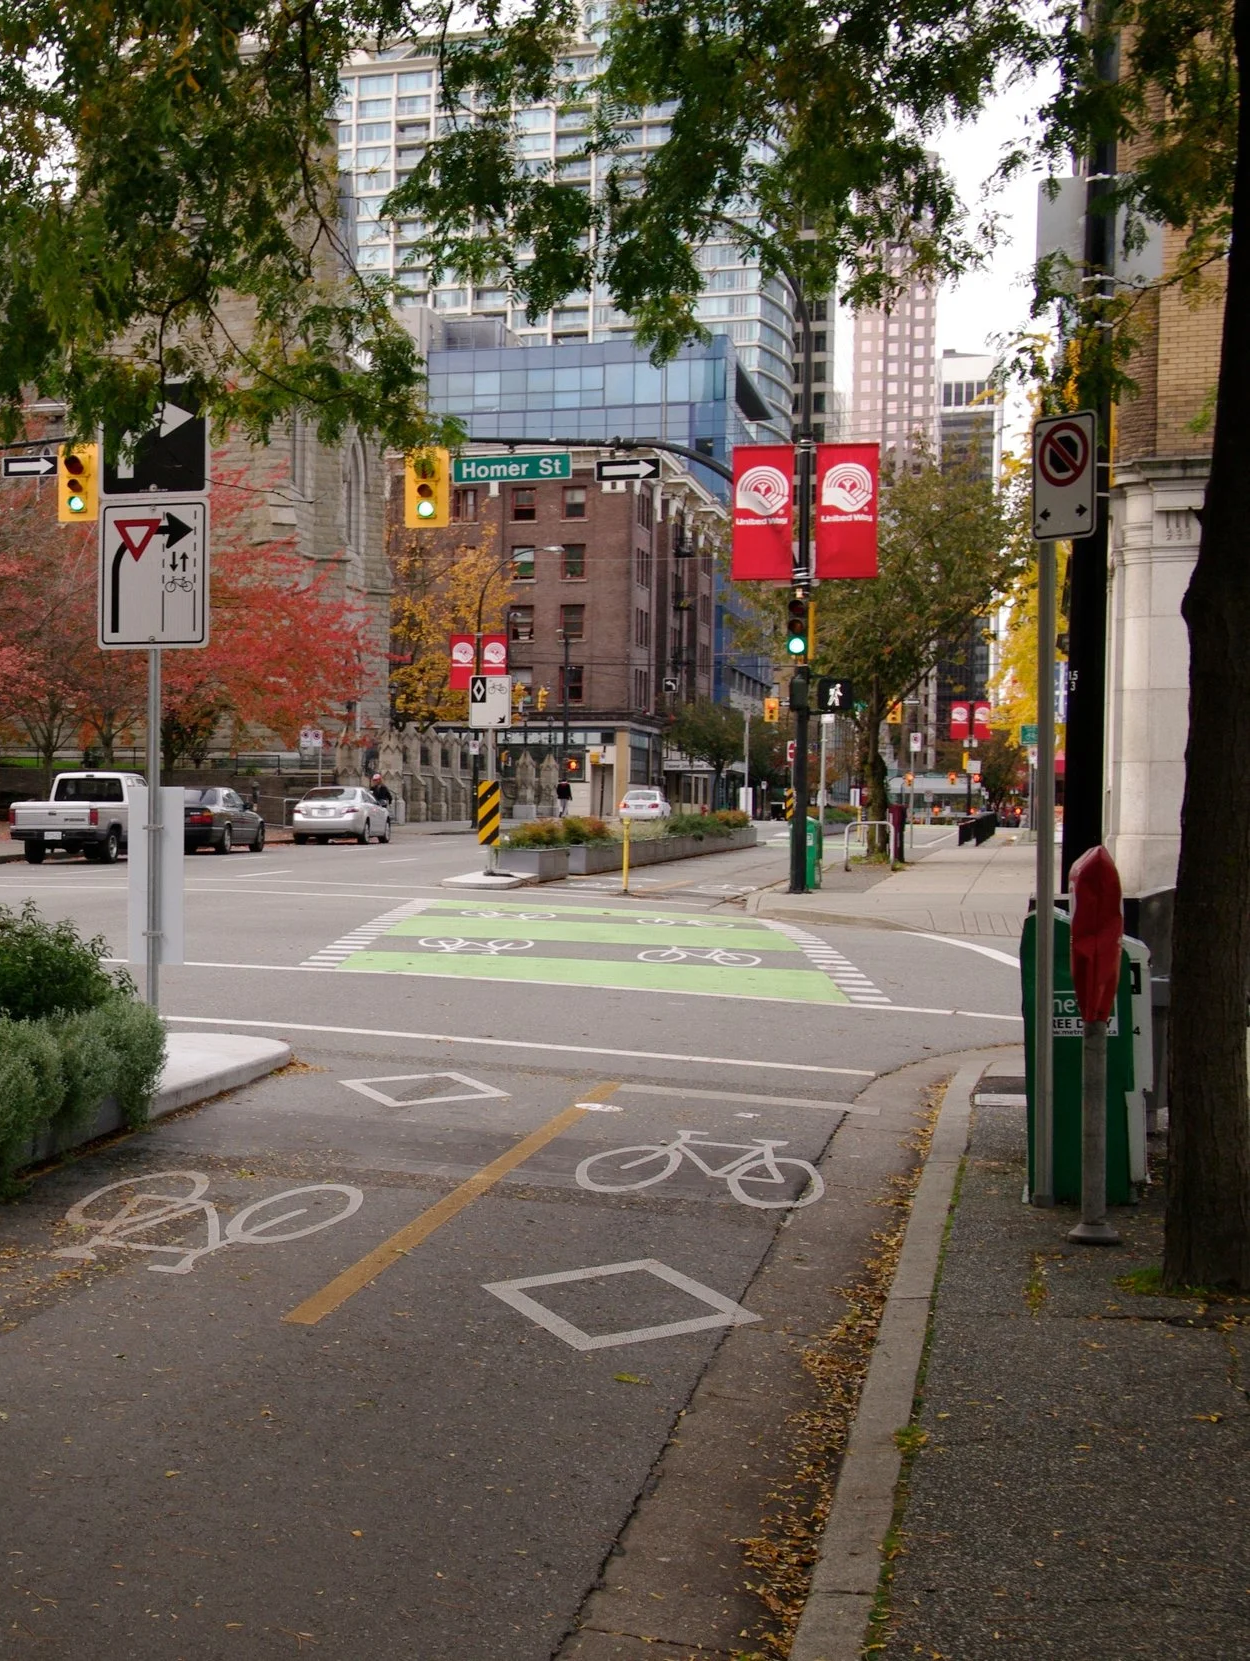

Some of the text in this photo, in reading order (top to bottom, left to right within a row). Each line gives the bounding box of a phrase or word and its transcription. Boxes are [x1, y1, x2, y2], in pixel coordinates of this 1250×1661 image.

[461, 457, 562, 479] Homer St
[735, 516, 789, 525] United Way
[820, 513, 874, 523] United Way
[1068, 670, 1079, 681] 15
[1070, 681, 1076, 691] 3
